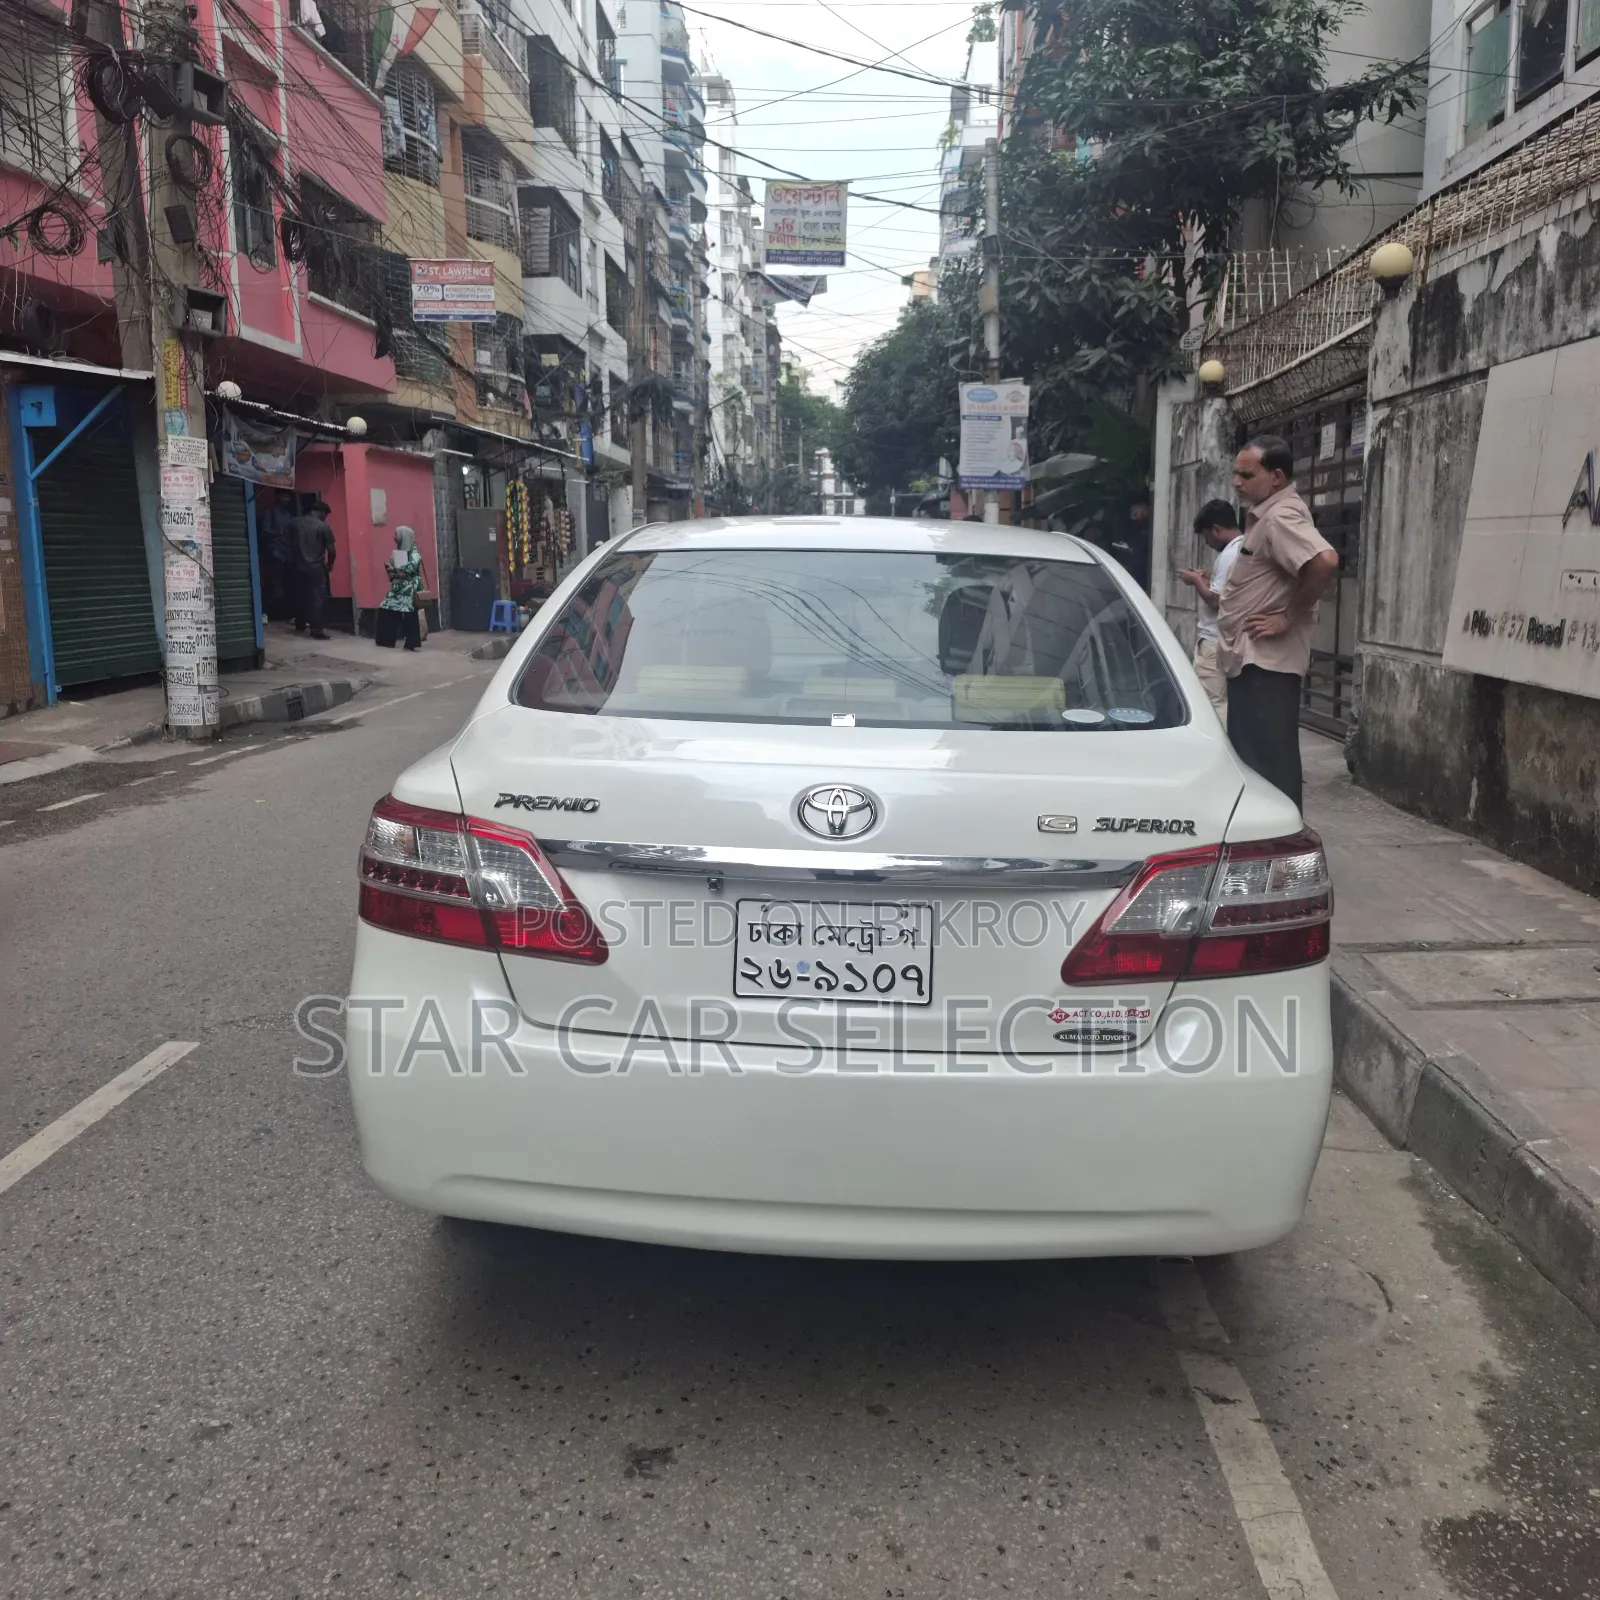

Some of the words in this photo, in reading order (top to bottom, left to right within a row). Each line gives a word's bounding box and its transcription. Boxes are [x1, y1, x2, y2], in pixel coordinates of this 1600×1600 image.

[428, 267, 441, 276] ST.
[443, 267, 491, 277] LAWRENCE
[417, 285, 439, 293] 70%
[1526, 616, 1567, 648] Road
[494, 792, 600, 814] PREMIO
[1092, 815, 1198, 836] SUPERIOR
[747, 920, 805, 945] ঢাকা
[740, 956, 925, 996] ২৬-৯১০৭
[1072, 1010, 1089, 1018] ACT
